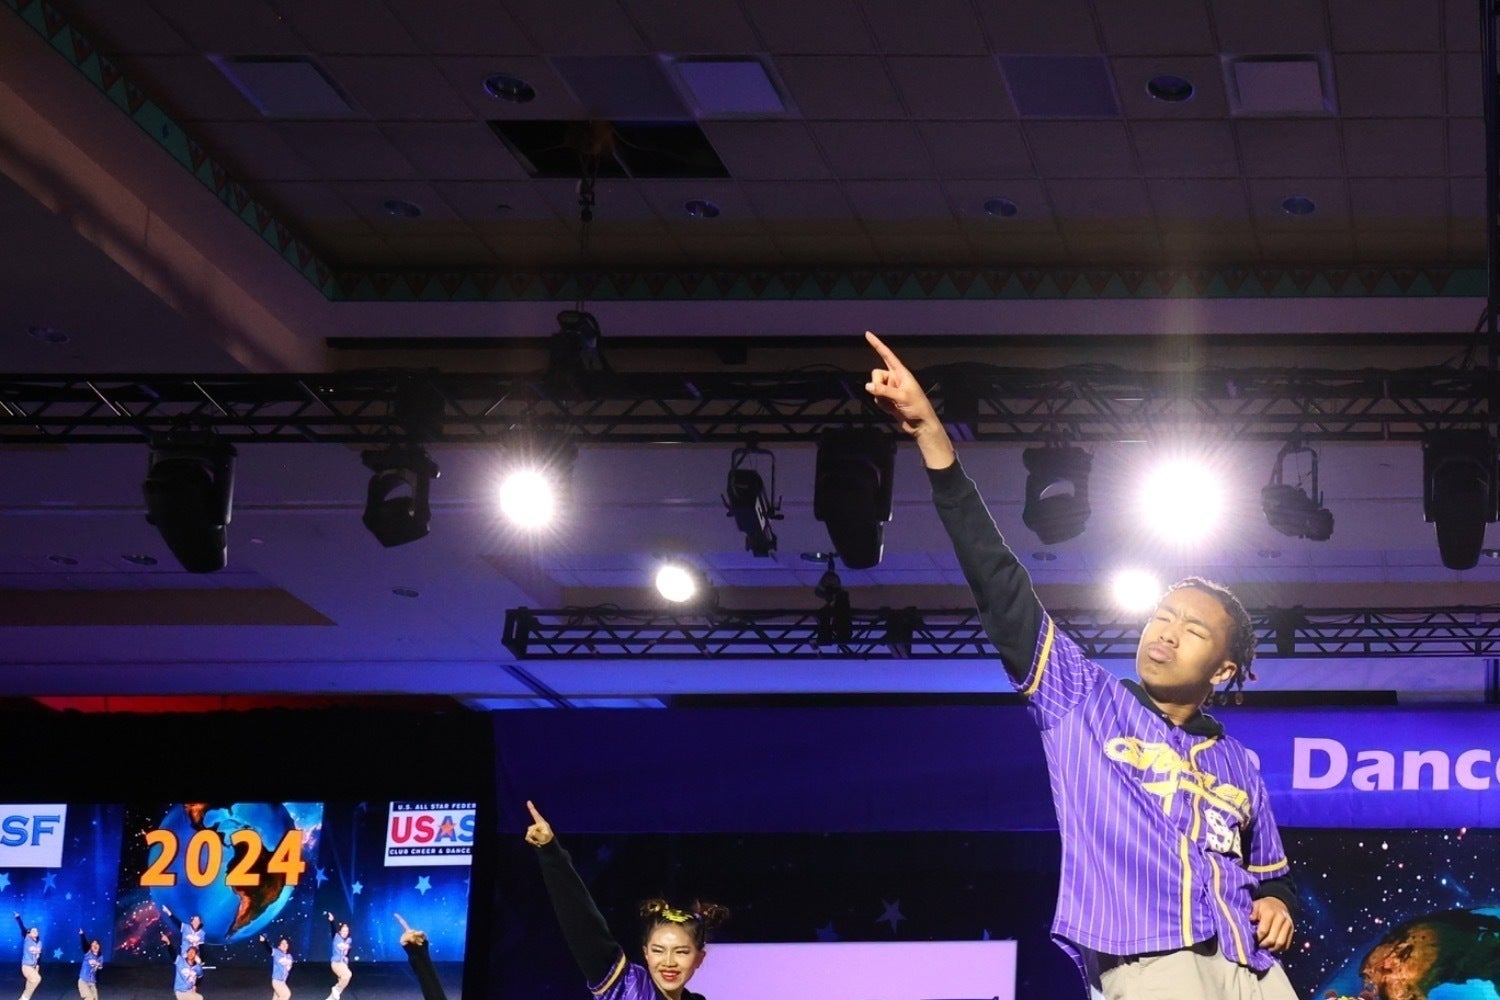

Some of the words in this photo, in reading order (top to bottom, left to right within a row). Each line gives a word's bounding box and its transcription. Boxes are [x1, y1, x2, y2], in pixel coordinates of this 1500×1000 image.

[0, 815, 60, 847] SF
[391, 815, 476, 843] USAS
[140, 829, 306, 887] 2024
